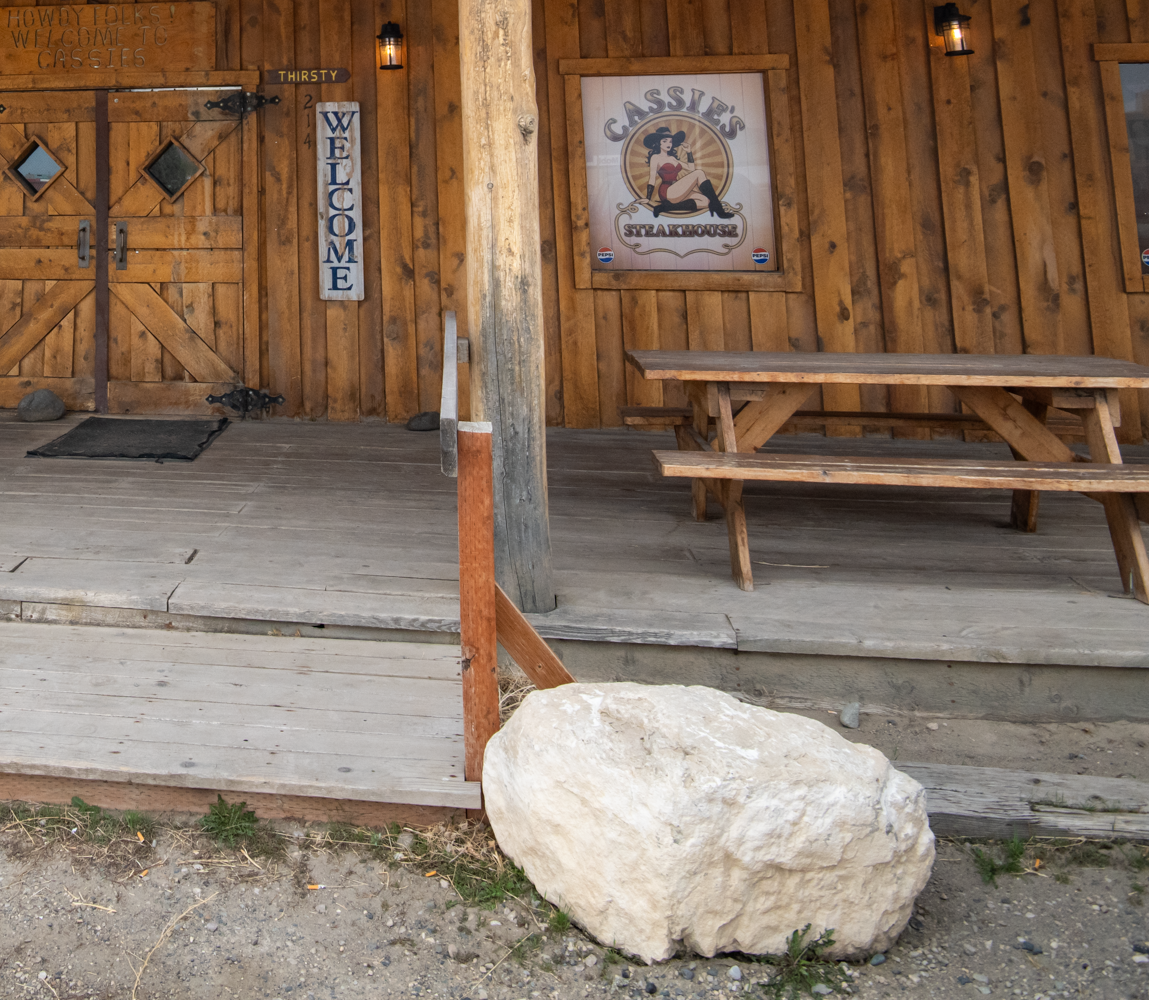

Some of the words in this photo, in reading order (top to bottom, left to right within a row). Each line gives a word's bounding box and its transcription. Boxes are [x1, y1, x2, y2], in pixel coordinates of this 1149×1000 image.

[7, 6, 84, 28] HOWDY
[11, 27, 126, 48] WELCOME
[140, 26, 168, 46] TO
[37, 48, 146, 69] CASSIES
[278, 70, 338, 82] THIRSTY
[604, 86, 746, 143] CASSIE'S
[319, 110, 359, 291] WELCOME
[623, 224, 739, 238] STEAKHOUSE
